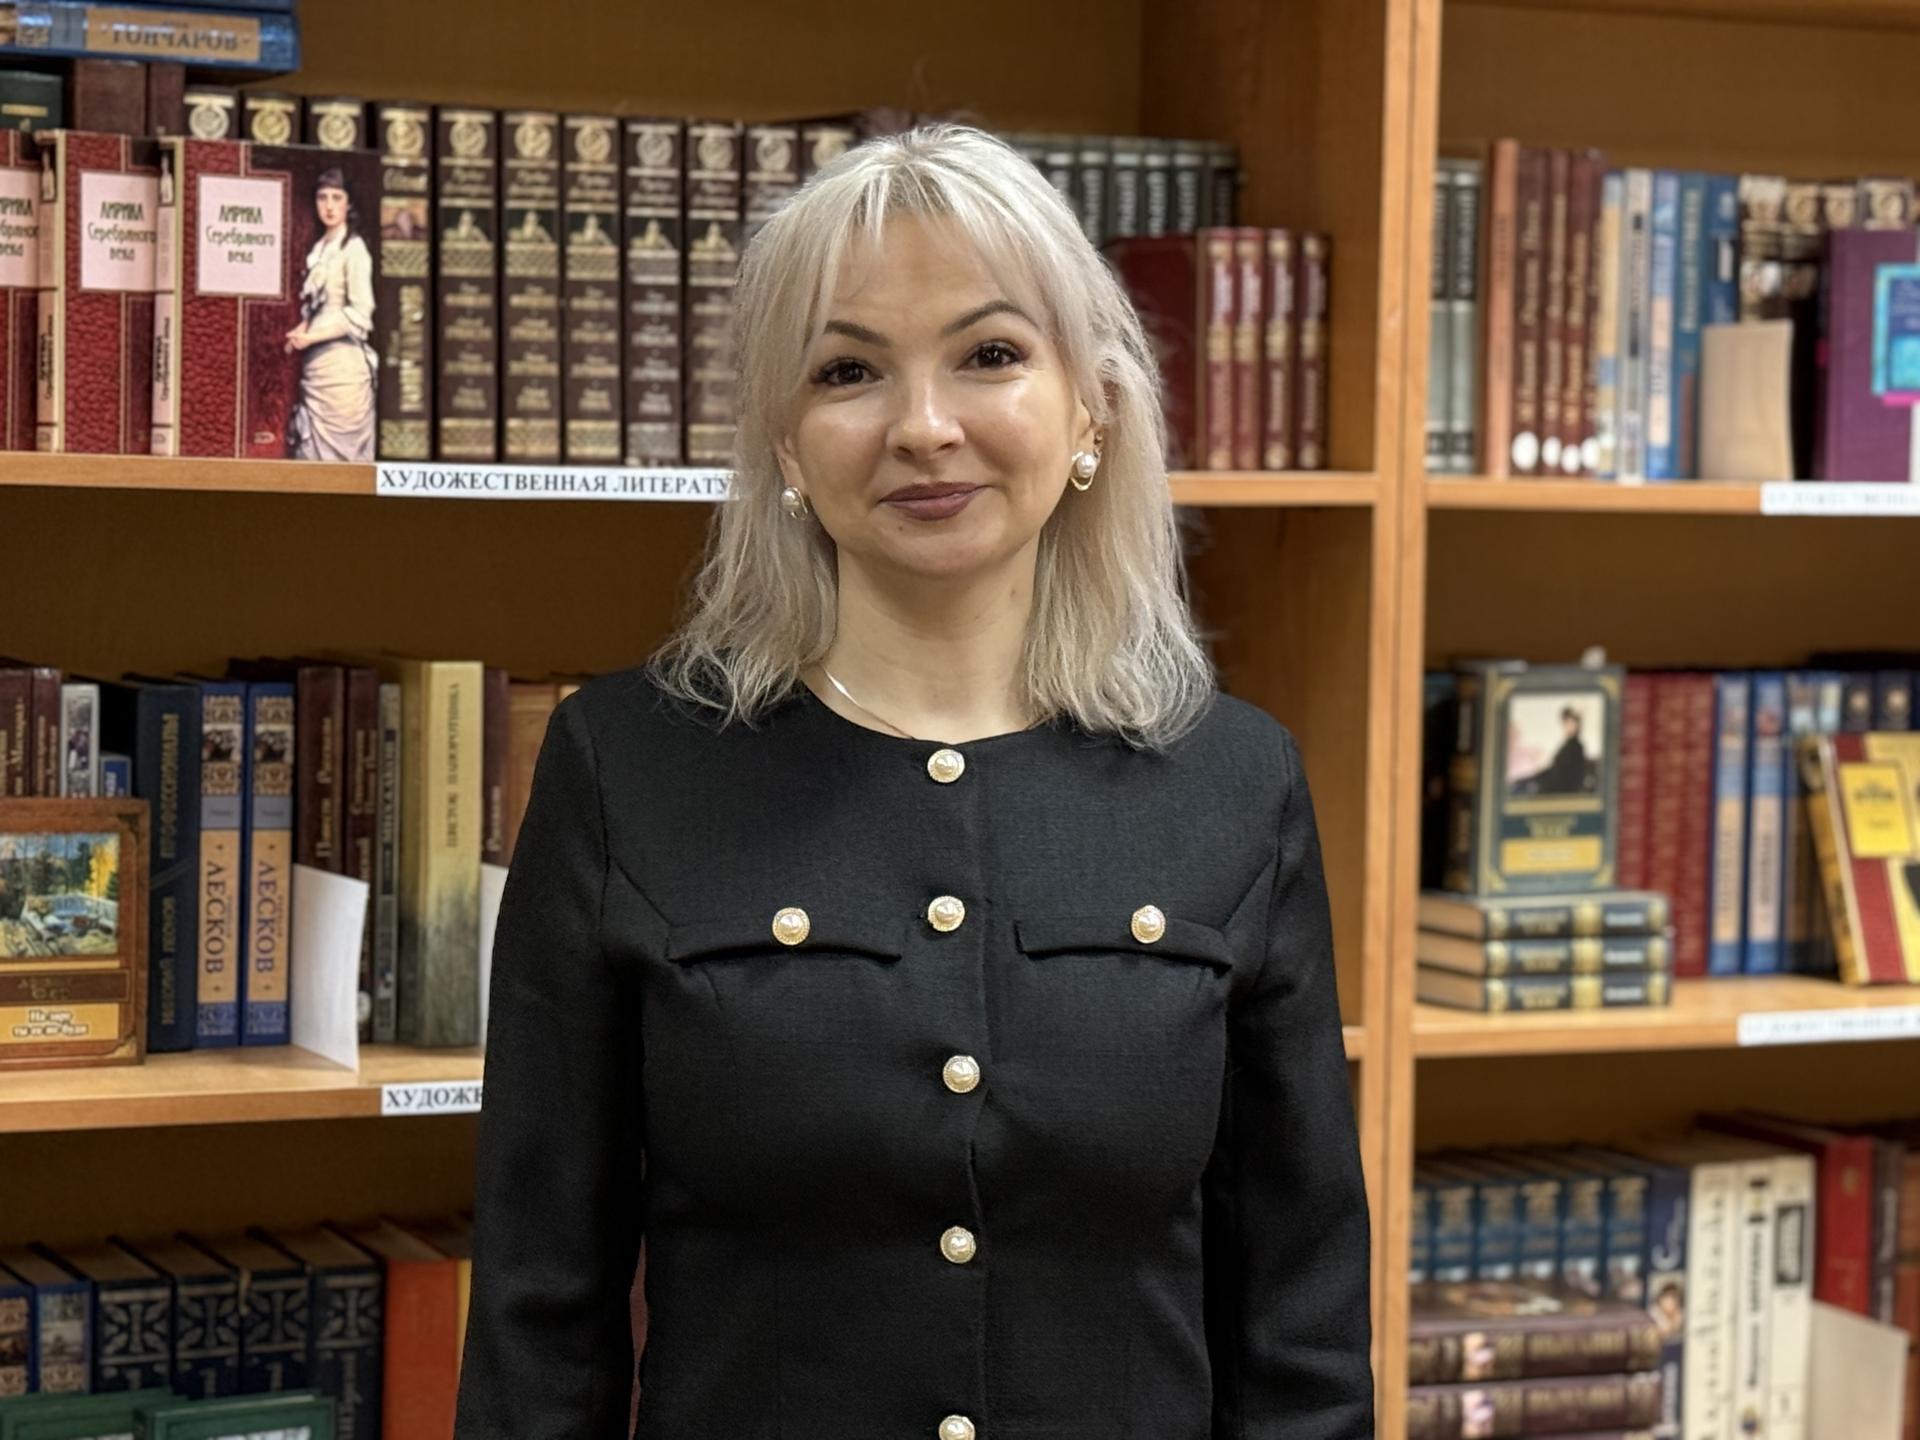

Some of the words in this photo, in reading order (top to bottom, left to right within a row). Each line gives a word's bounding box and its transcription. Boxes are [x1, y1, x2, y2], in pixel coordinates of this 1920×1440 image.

[112, 25, 238, 52] ГОНЧАРОВ
[100, 201, 144, 220] ЛИРИКА
[218, 204, 263, 224] ЛИРИКА
[205, 225, 275, 246] Серебряного
[109, 247, 135, 261] века
[228, 250, 253, 263] века
[381, 470, 607, 493] ХУДОЖЕСТВЕННАЯ
[205, 860, 226, 974] ЛЕСКОВ
[255, 860, 277, 973] ЛЕСКОВ
